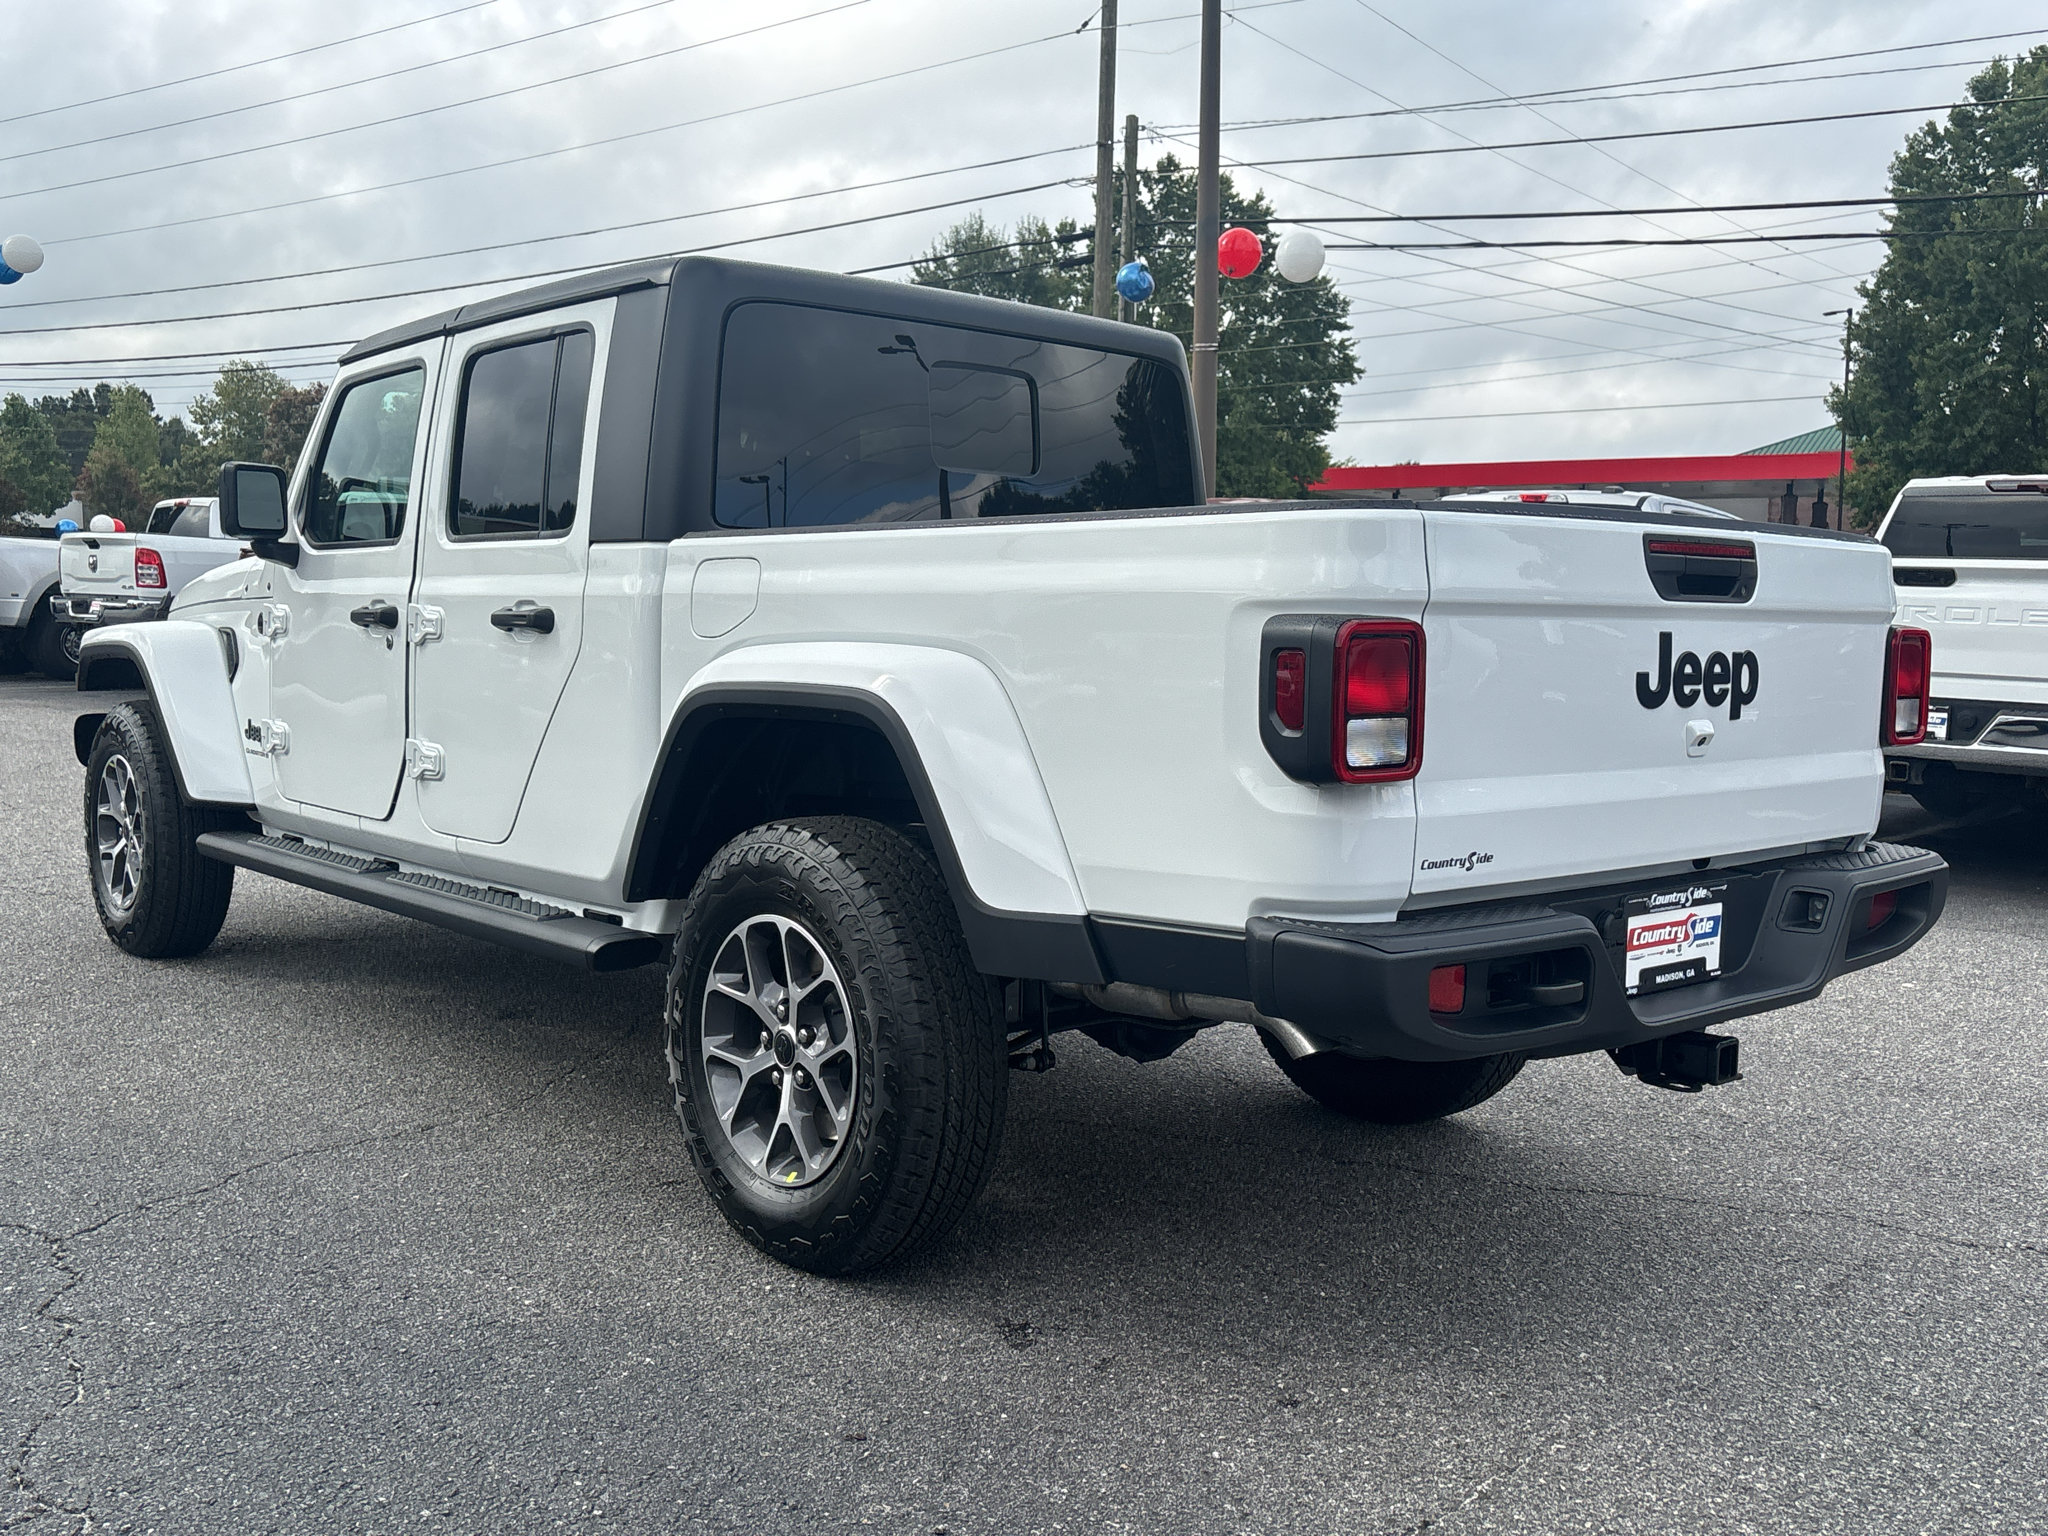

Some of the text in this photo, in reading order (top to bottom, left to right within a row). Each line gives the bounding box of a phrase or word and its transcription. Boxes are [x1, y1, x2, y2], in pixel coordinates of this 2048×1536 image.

[1636, 631, 1759, 721] Jeep
[245, 718, 262, 743] Jee
[1655, 968, 1695, 984] MADISON, GA
